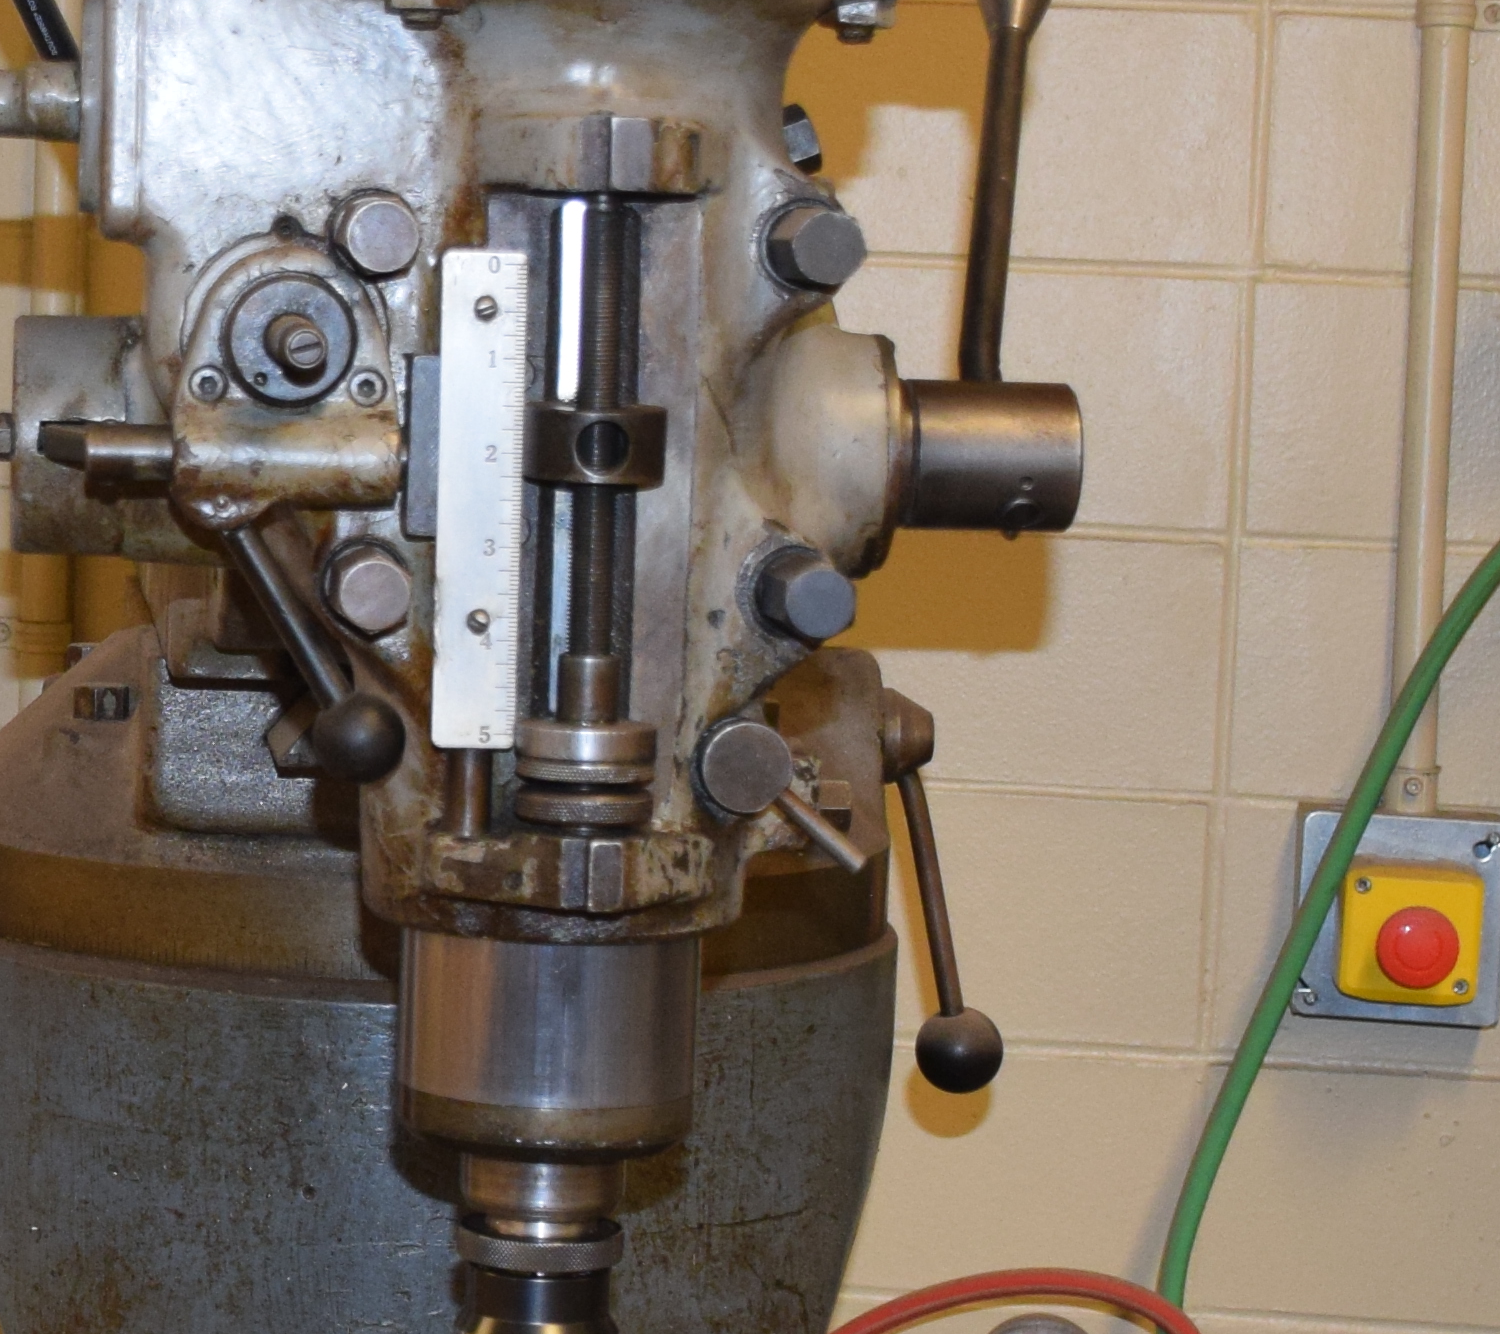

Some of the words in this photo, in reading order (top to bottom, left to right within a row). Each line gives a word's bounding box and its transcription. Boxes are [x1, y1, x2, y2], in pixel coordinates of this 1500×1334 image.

[488, 255, 501, 274] 0
[489, 350, 497, 368] 1
[485, 444, 498, 463] 2
[483, 538, 496, 557] 3
[480, 632, 492, 650] 4
[478, 725, 491, 744] 5
